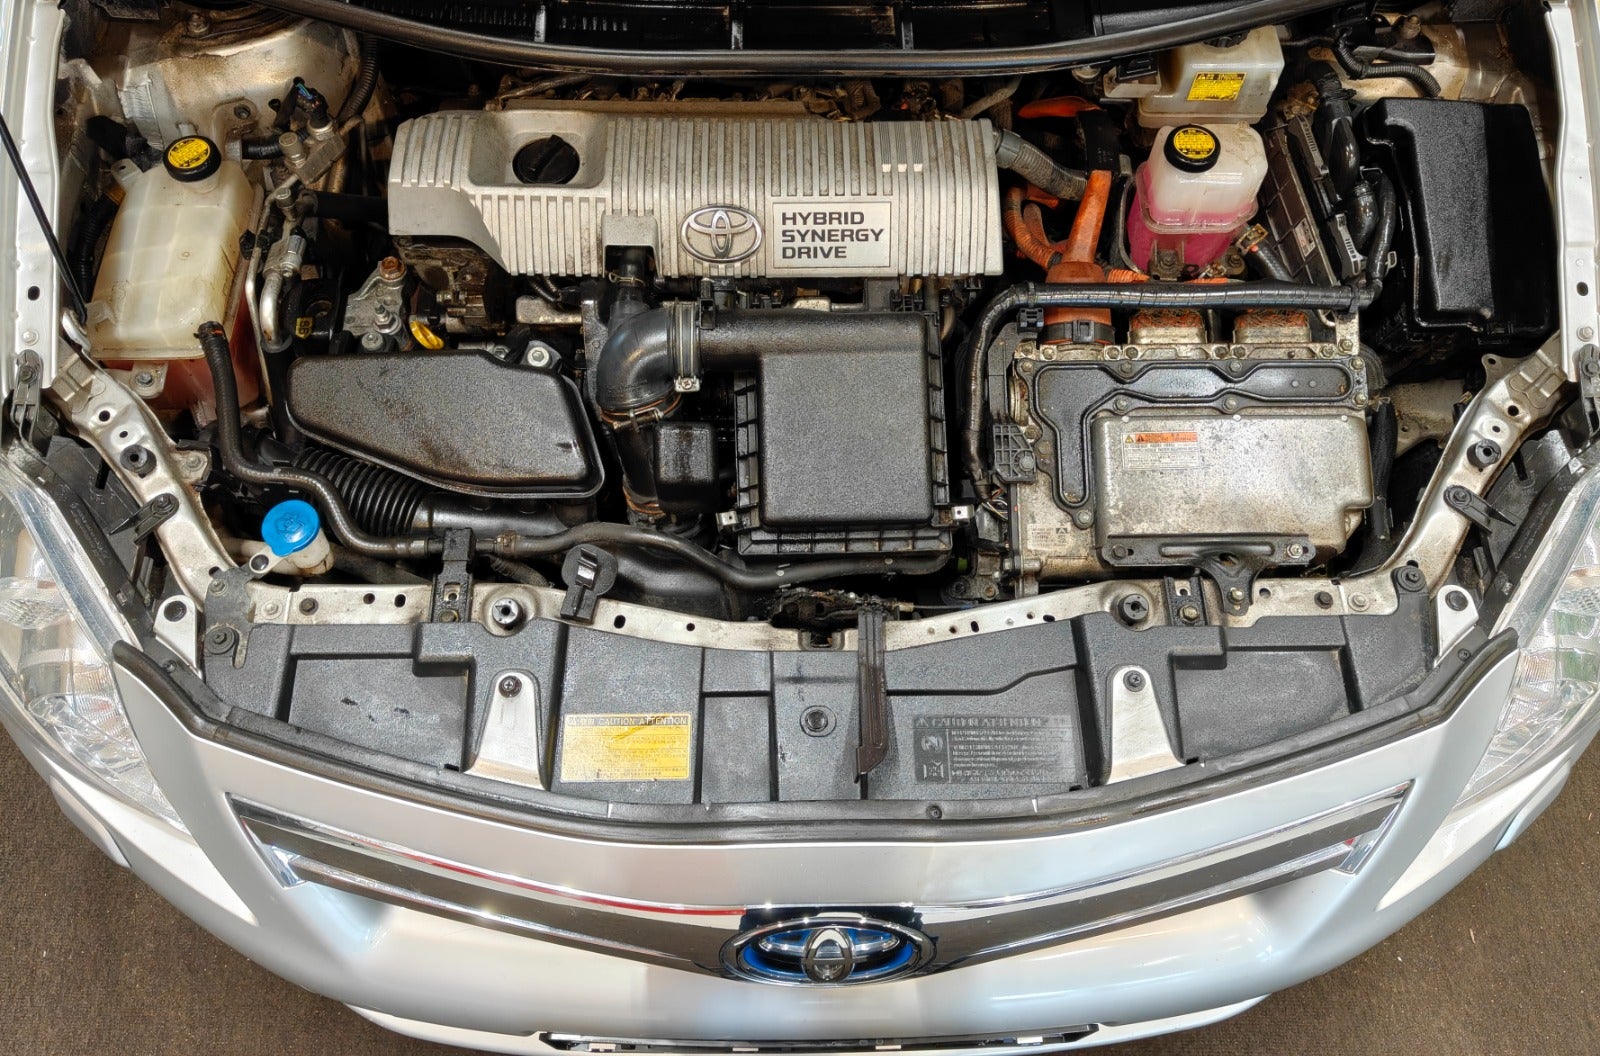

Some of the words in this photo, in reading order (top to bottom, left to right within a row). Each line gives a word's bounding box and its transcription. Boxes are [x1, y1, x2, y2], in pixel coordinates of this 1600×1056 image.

[781, 211, 865, 226] HYBRID
[781, 228, 885, 243] SYNERGY
[781, 246, 848, 260] DRIVE
[598, 717, 637, 726] CAUTION
[638, 716, 688, 725] ATTENTION
